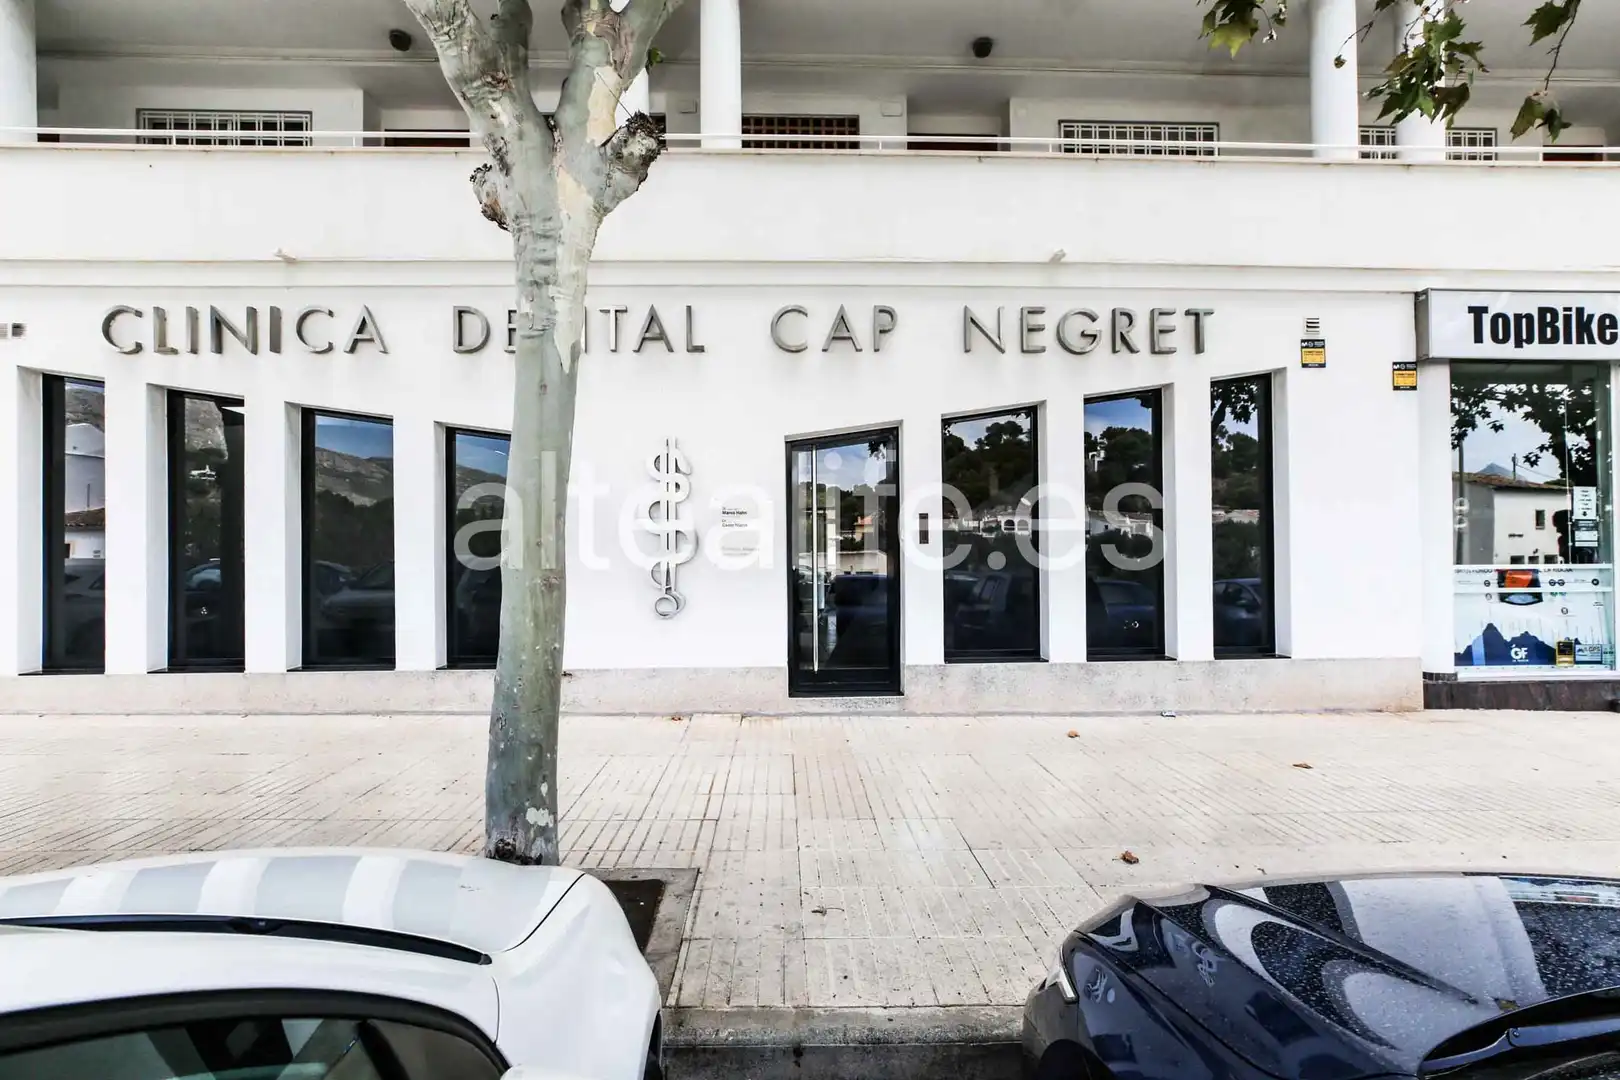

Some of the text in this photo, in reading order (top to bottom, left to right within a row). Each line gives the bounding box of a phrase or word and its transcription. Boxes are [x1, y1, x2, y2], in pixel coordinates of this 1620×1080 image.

[102, 304, 1215, 357] CLINICA DETAL CAP NEGRET
[1467, 305, 1619, 348] TopBike
